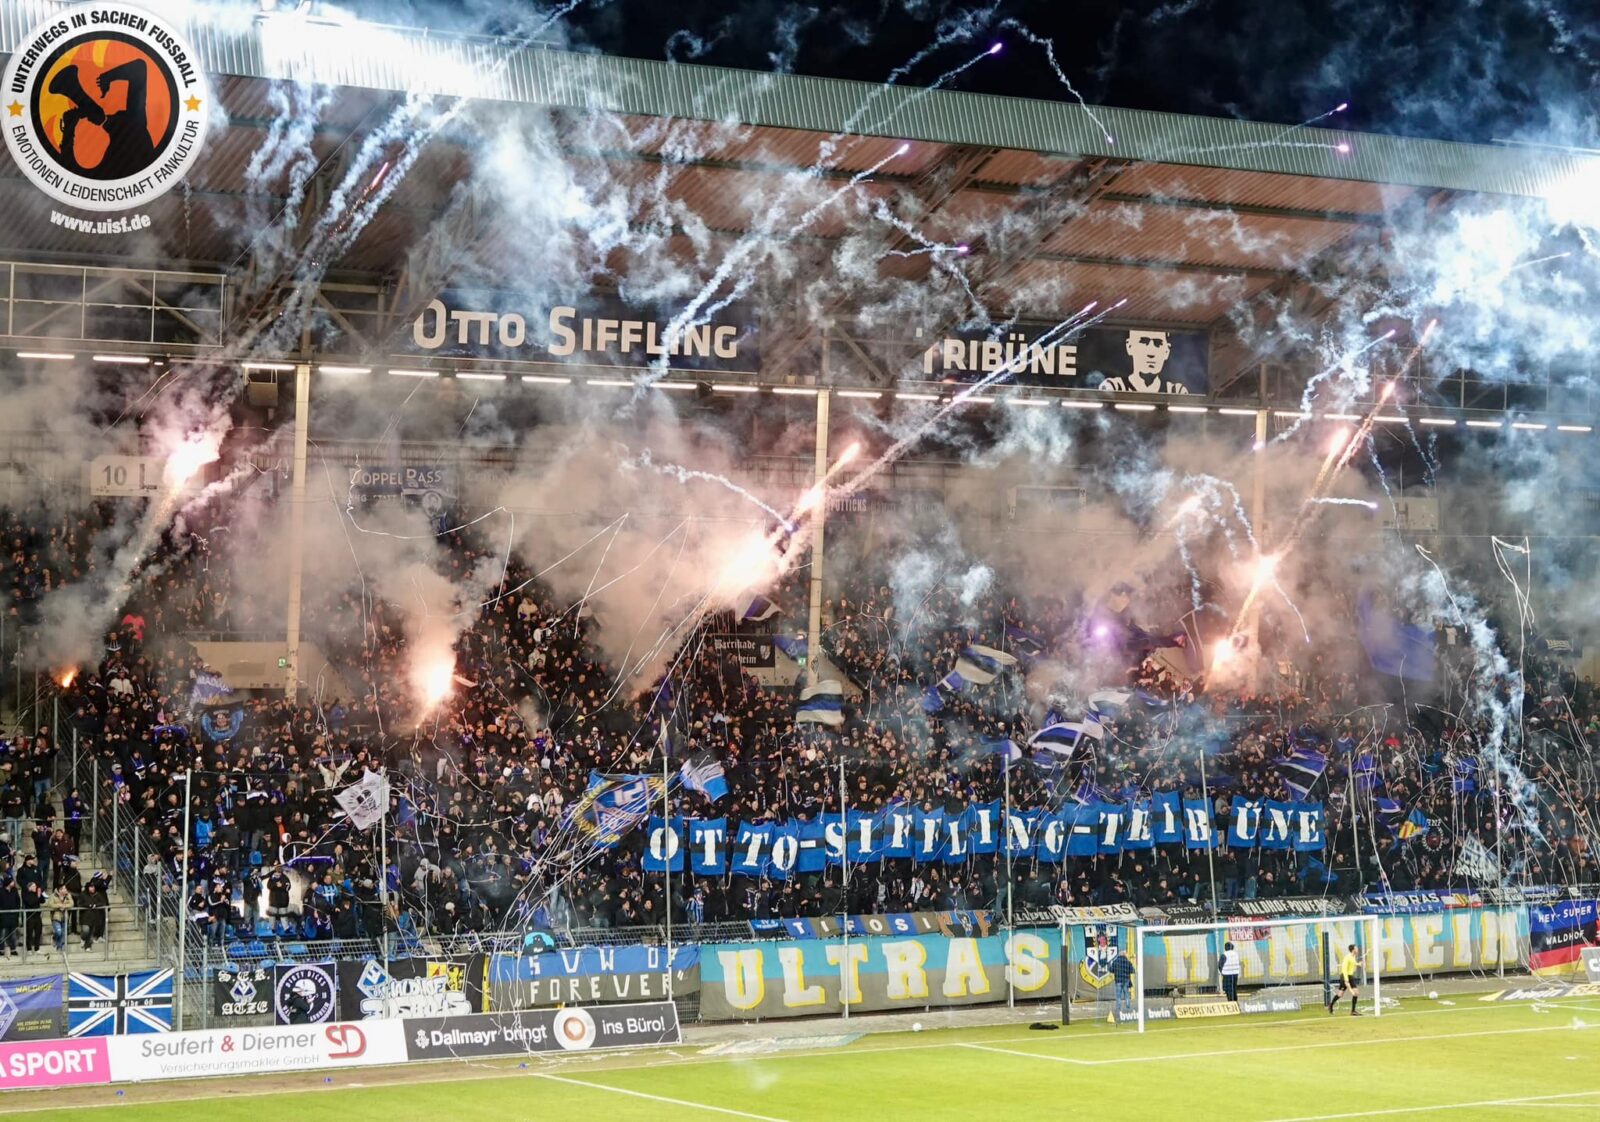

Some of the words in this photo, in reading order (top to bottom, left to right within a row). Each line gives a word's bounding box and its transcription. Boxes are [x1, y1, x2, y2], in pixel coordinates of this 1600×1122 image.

[413, 298, 526, 349] OTTO
[548, 306, 737, 358] SIFFLING
[350, 468, 402, 486] OPPEL
[1563, 905, 1592, 919] SUPER
[1546, 930, 1584, 945] WALDHOF
[717, 933, 1052, 1010] ULTRAS
[1119, 1010, 1139, 1021] bwi
[1148, 1008, 1171, 1018] bwin
[1177, 1003, 1239, 1018] SPORTWETTEN
[1244, 1002, 1266, 1012] bwin
[1272, 1000, 1294, 1010] bwin
[431, 1029, 497, 1047] Dallmayr
[503, 1024, 548, 1044] bringt
[602, 1019, 624, 1034] ins
[627, 1014, 666, 1033] Büro!
[141, 1036, 214, 1057] Seufert
[221, 1035, 235, 1052] &
[243, 1033, 317, 1051] Diemer
[10, 1048, 97, 1078] SPORT
[160, 1058, 280, 1074] Versicherungsmakler
[283, 1055, 320, 1066] GmbH
